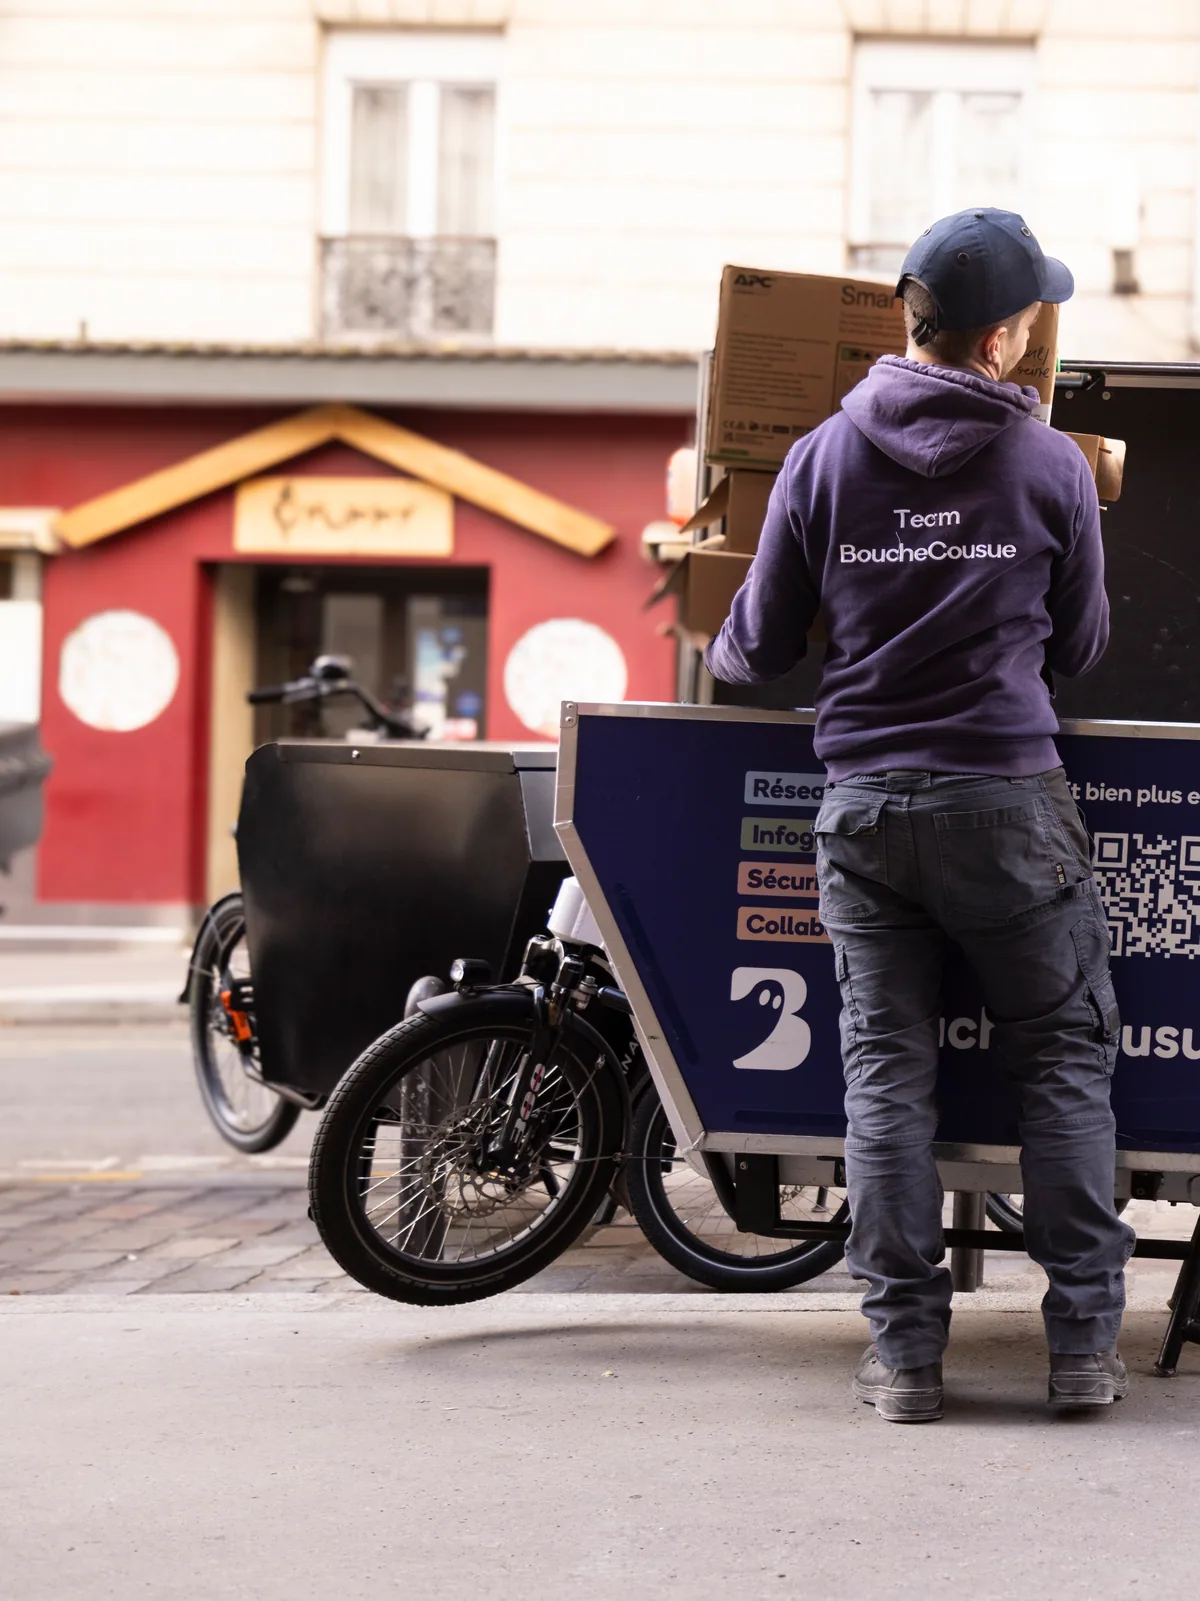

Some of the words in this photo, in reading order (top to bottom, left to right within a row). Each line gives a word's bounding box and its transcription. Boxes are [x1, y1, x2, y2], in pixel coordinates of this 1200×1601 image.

[734, 274, 772, 288] APC
[841, 286, 904, 309] Smar
[893, 509, 961, 529] Team
[839, 541, 1017, 564] BoucheCousue
[1085, 782, 1132, 802] bien
[1136, 785, 1183, 808] plus
